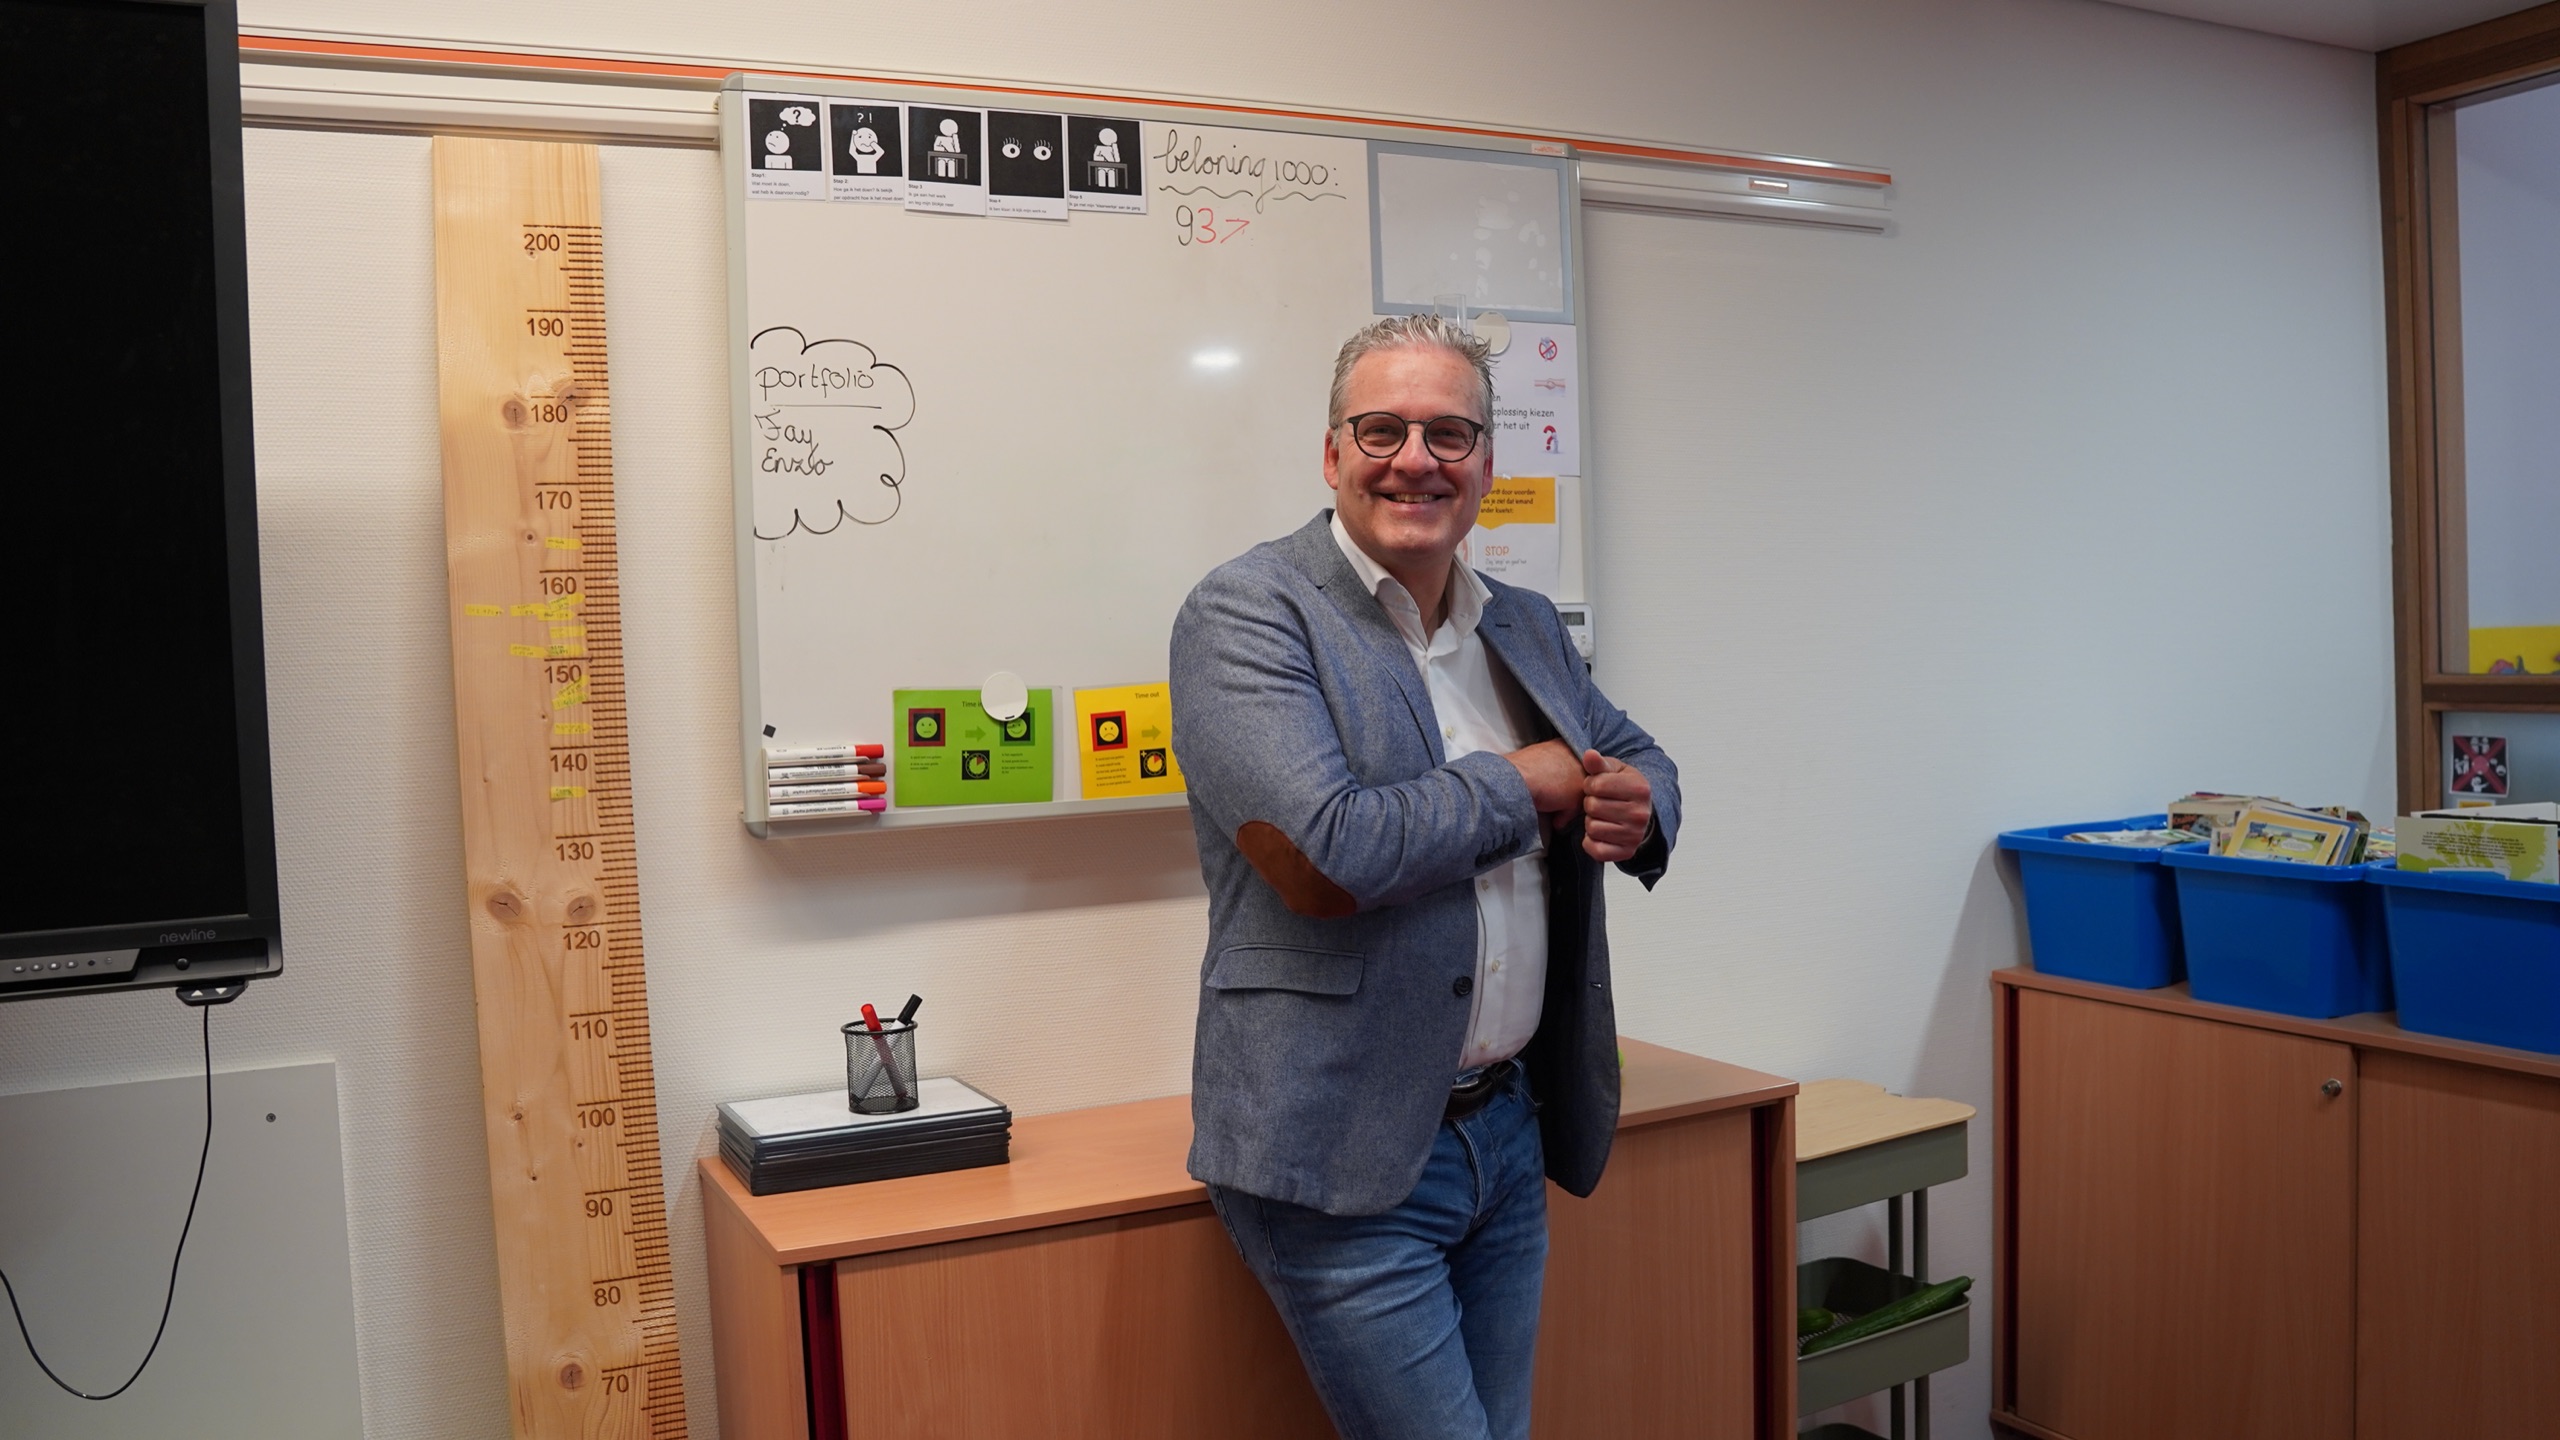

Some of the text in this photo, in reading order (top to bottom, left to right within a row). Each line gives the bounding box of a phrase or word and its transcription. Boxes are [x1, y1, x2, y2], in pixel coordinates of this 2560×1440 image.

[1153, 129, 1339, 214] beloning 1000:
[1176, 204, 1217, 246] 93
[524, 233, 560, 251] 200
[526, 318, 564, 337] 190
[530, 404, 568, 423] 180
[1529, 408, 1555, 418] kiezen
[1503, 421, 1517, 430] het
[1519, 421, 1530, 430] uit
[535, 490, 573, 510] 170
[1485, 546, 1510, 557] STOP
[540, 576, 577, 595] 160
[544, 664, 582, 684] 150
[550, 752, 588, 773] 140
[555, 841, 594, 861] 130
[160, 928, 217, 943] newline
[563, 930, 601, 951] 120
[569, 1018, 608, 1040] 110
[577, 1108, 616, 1129] 100
[585, 1197, 613, 1218] 90
[593, 1286, 621, 1307] 80
[602, 1374, 629, 1396] 70
